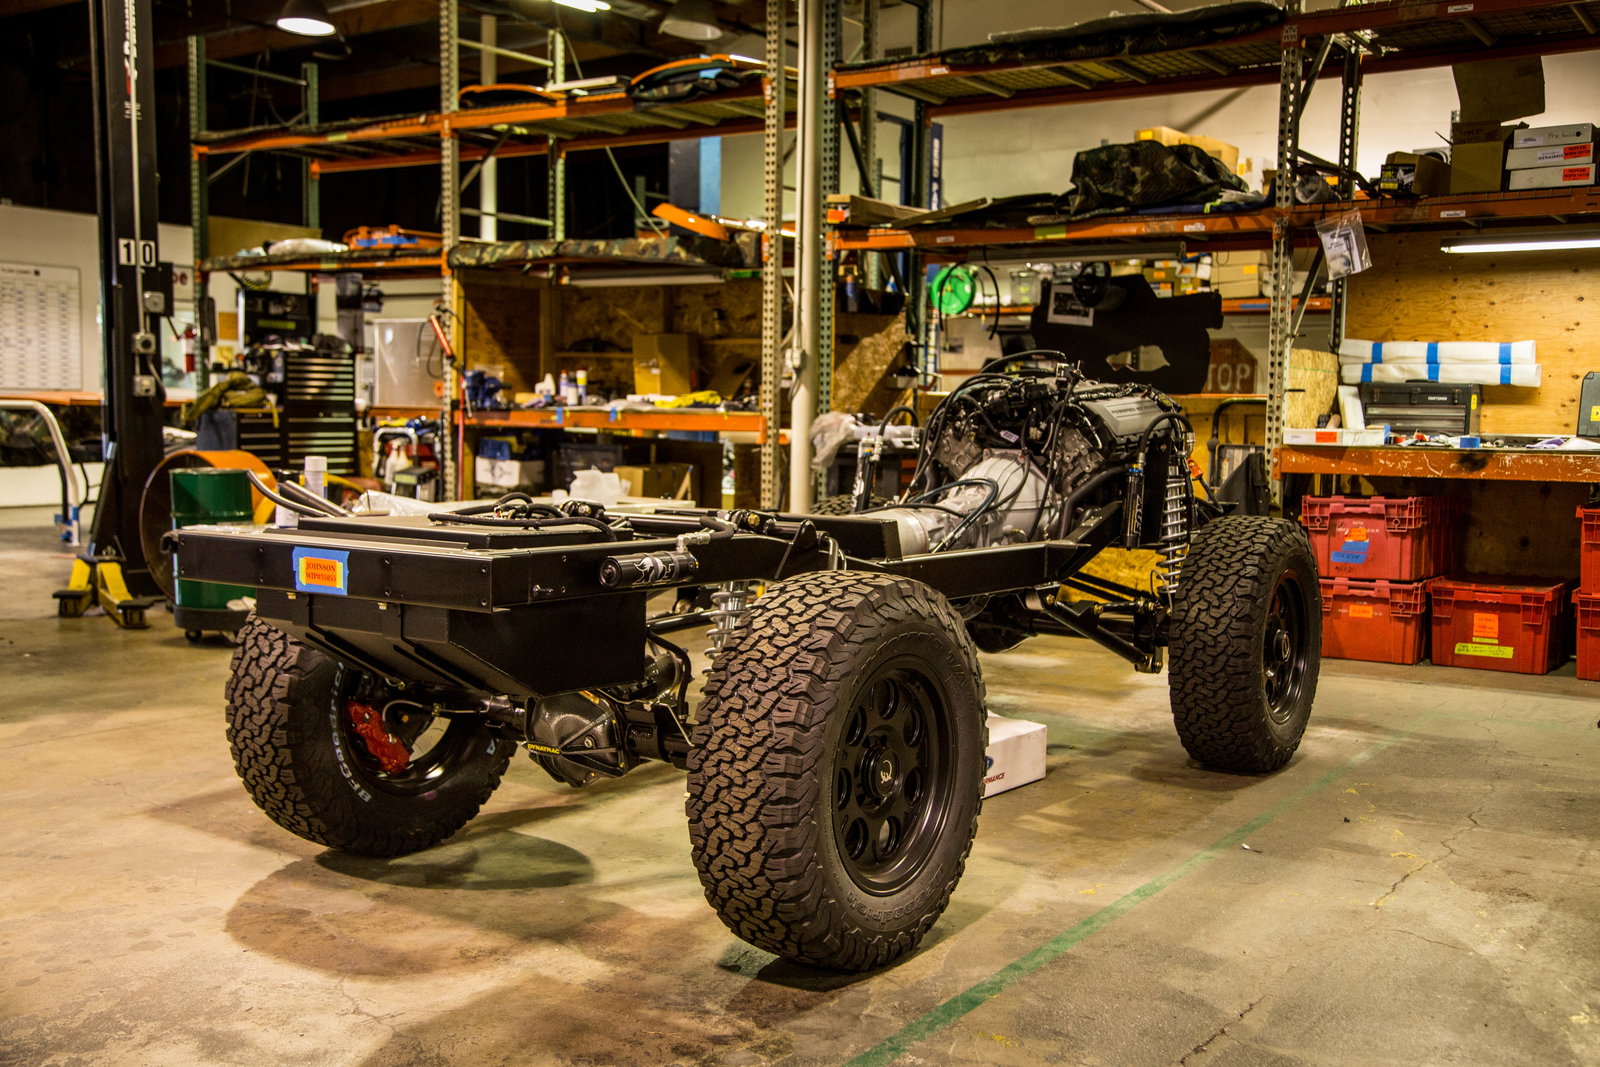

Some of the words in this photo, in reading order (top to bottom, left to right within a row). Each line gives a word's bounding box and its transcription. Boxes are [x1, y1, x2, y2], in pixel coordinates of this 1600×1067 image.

[121, 241, 155, 265] 10
[1207, 363, 1251, 391] TOP
[306, 562, 335, 572] JOHNSON
[527, 743, 560, 755] DYNATRAC
